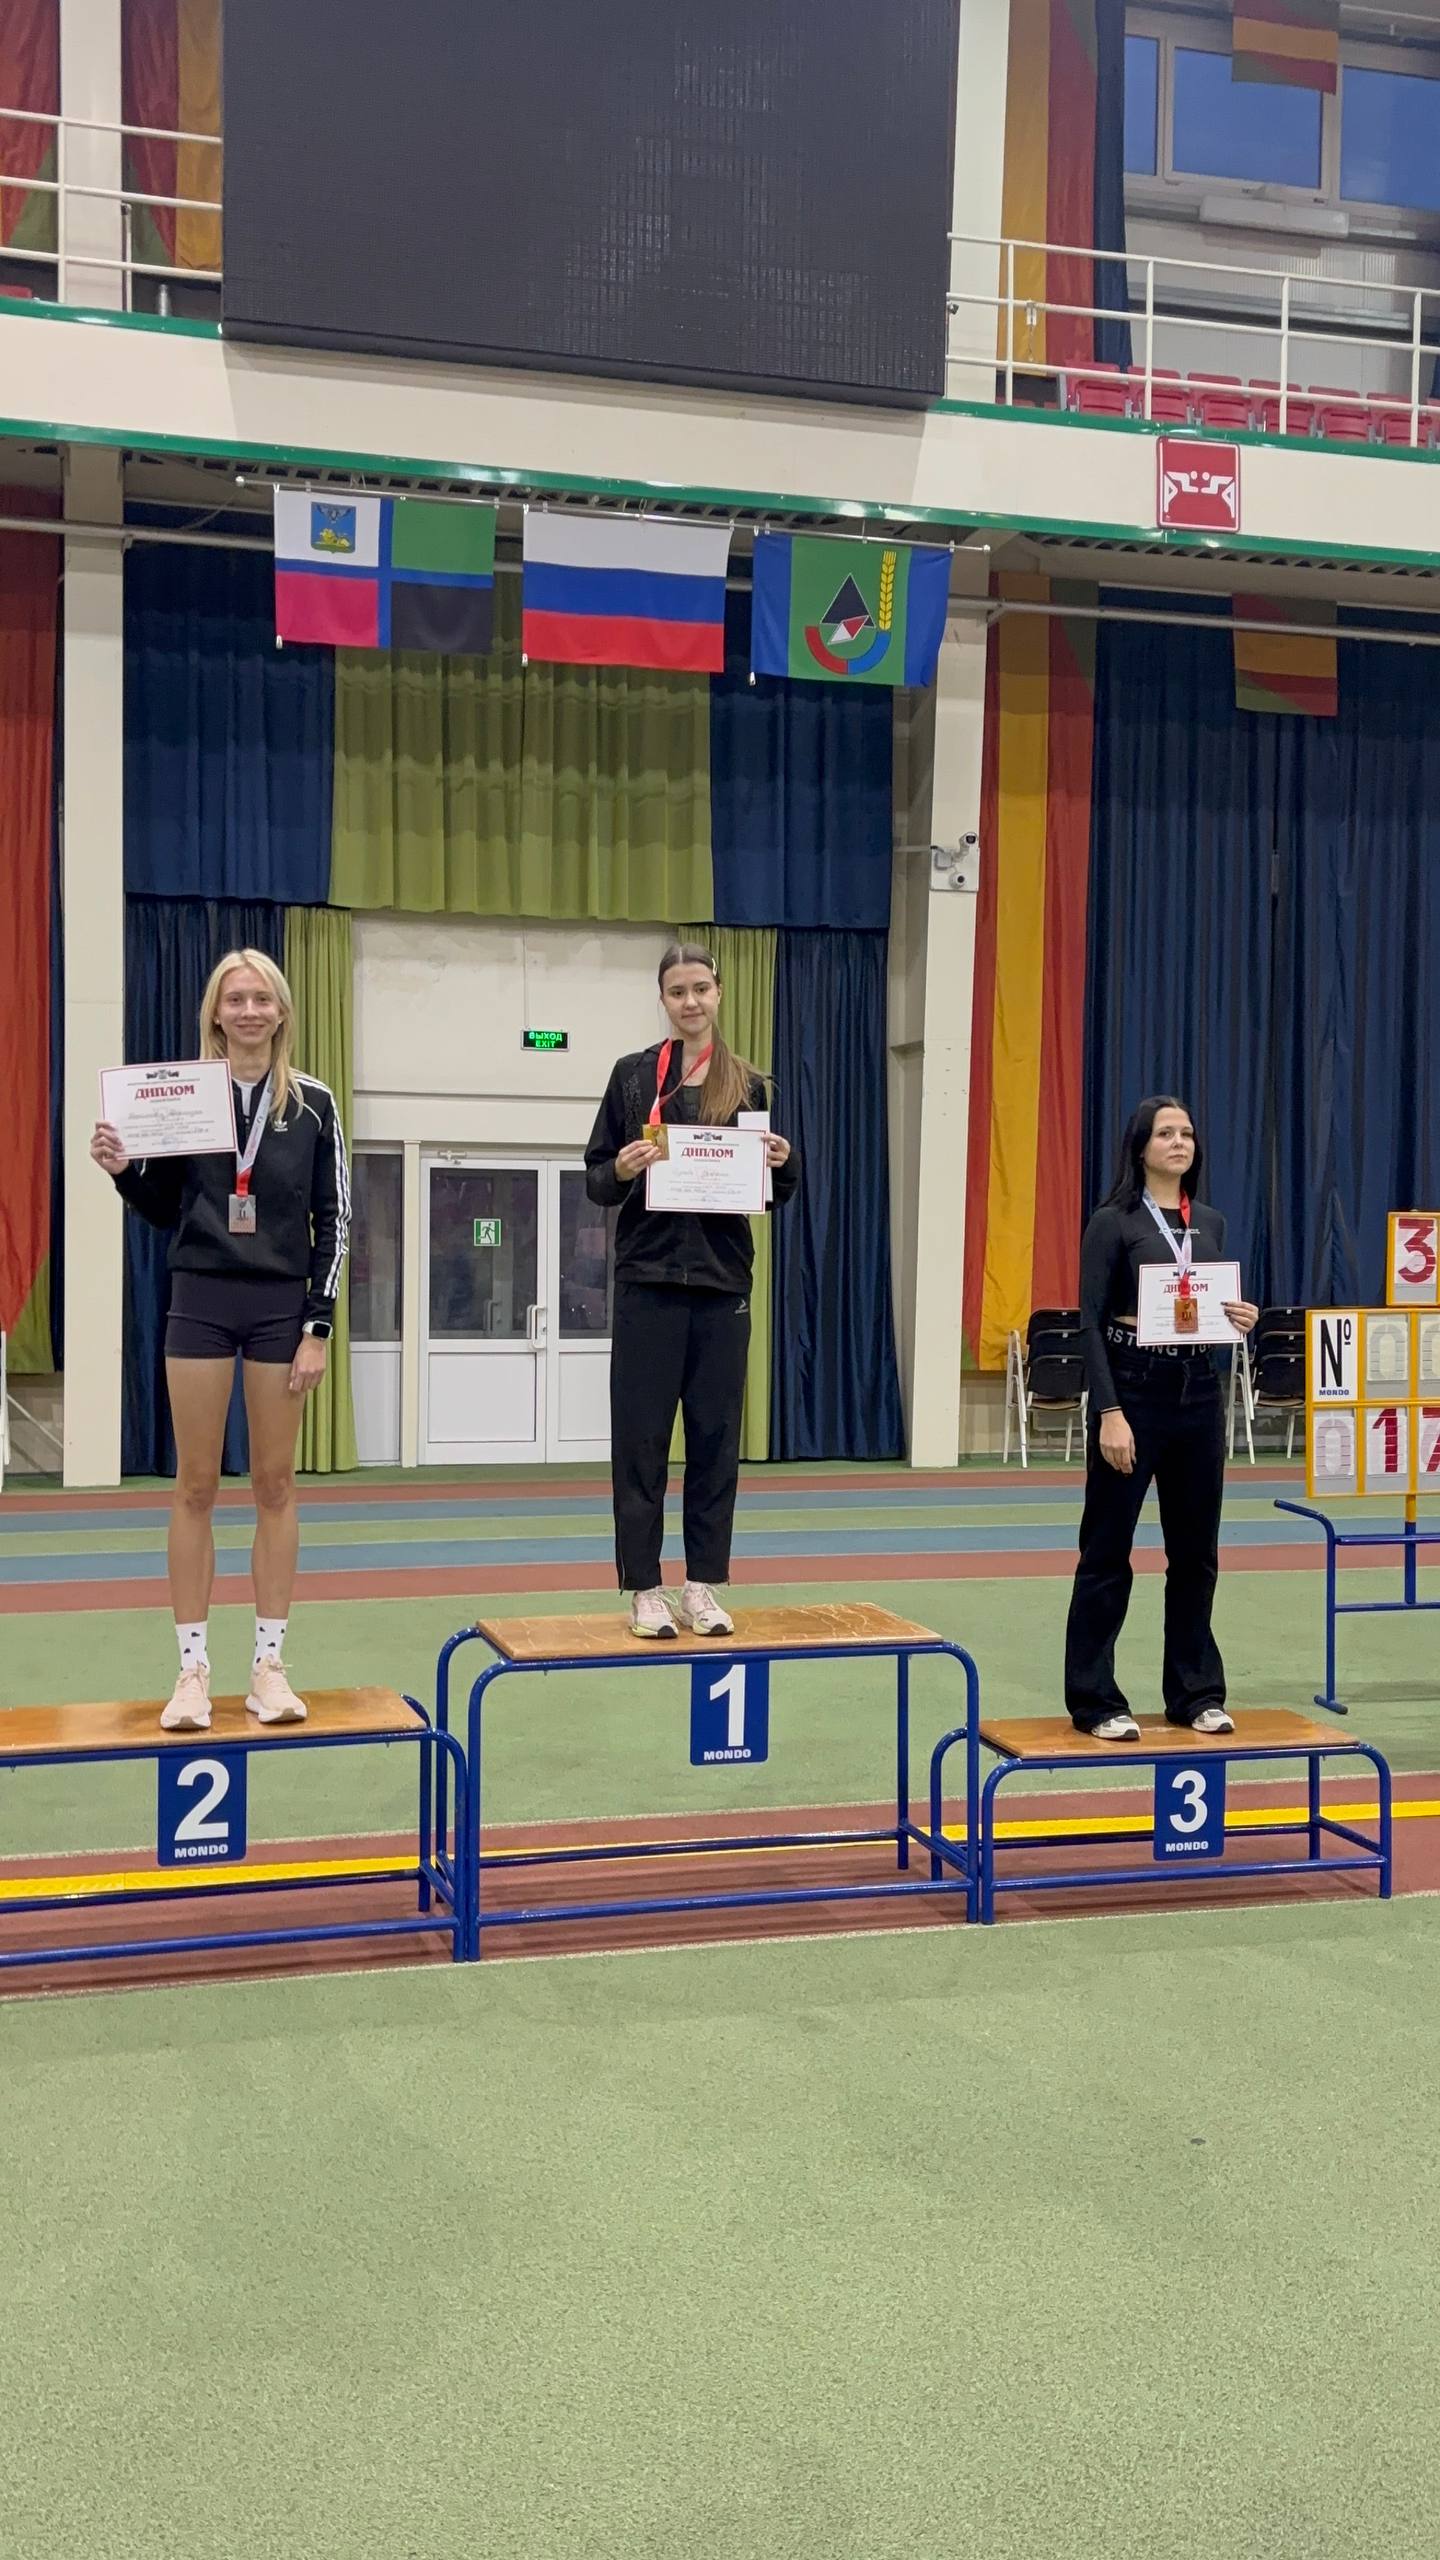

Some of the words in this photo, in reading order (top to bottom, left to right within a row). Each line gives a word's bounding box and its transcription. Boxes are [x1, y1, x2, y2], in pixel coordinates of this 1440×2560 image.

[528, 1031, 563, 1041] ВЫХОД
[535, 1040, 556, 1048] EXIT
[134, 1084, 195, 1101] ДИПЛОМ
[681, 1146, 734, 1159] ДИПЛОМ
[1398, 1218, 1436, 1284] 3
[1163, 1283, 1209, 1294] ДИОМ
[709, 1664, 746, 1747] 1
[703, 1748, 751, 1760] MONDO
[174, 1758, 230, 1841] 2
[1169, 1769, 1208, 1833] 3
[174, 1843, 229, 1859] MONDO
[1165, 1841, 1209, 1852] MONDO
